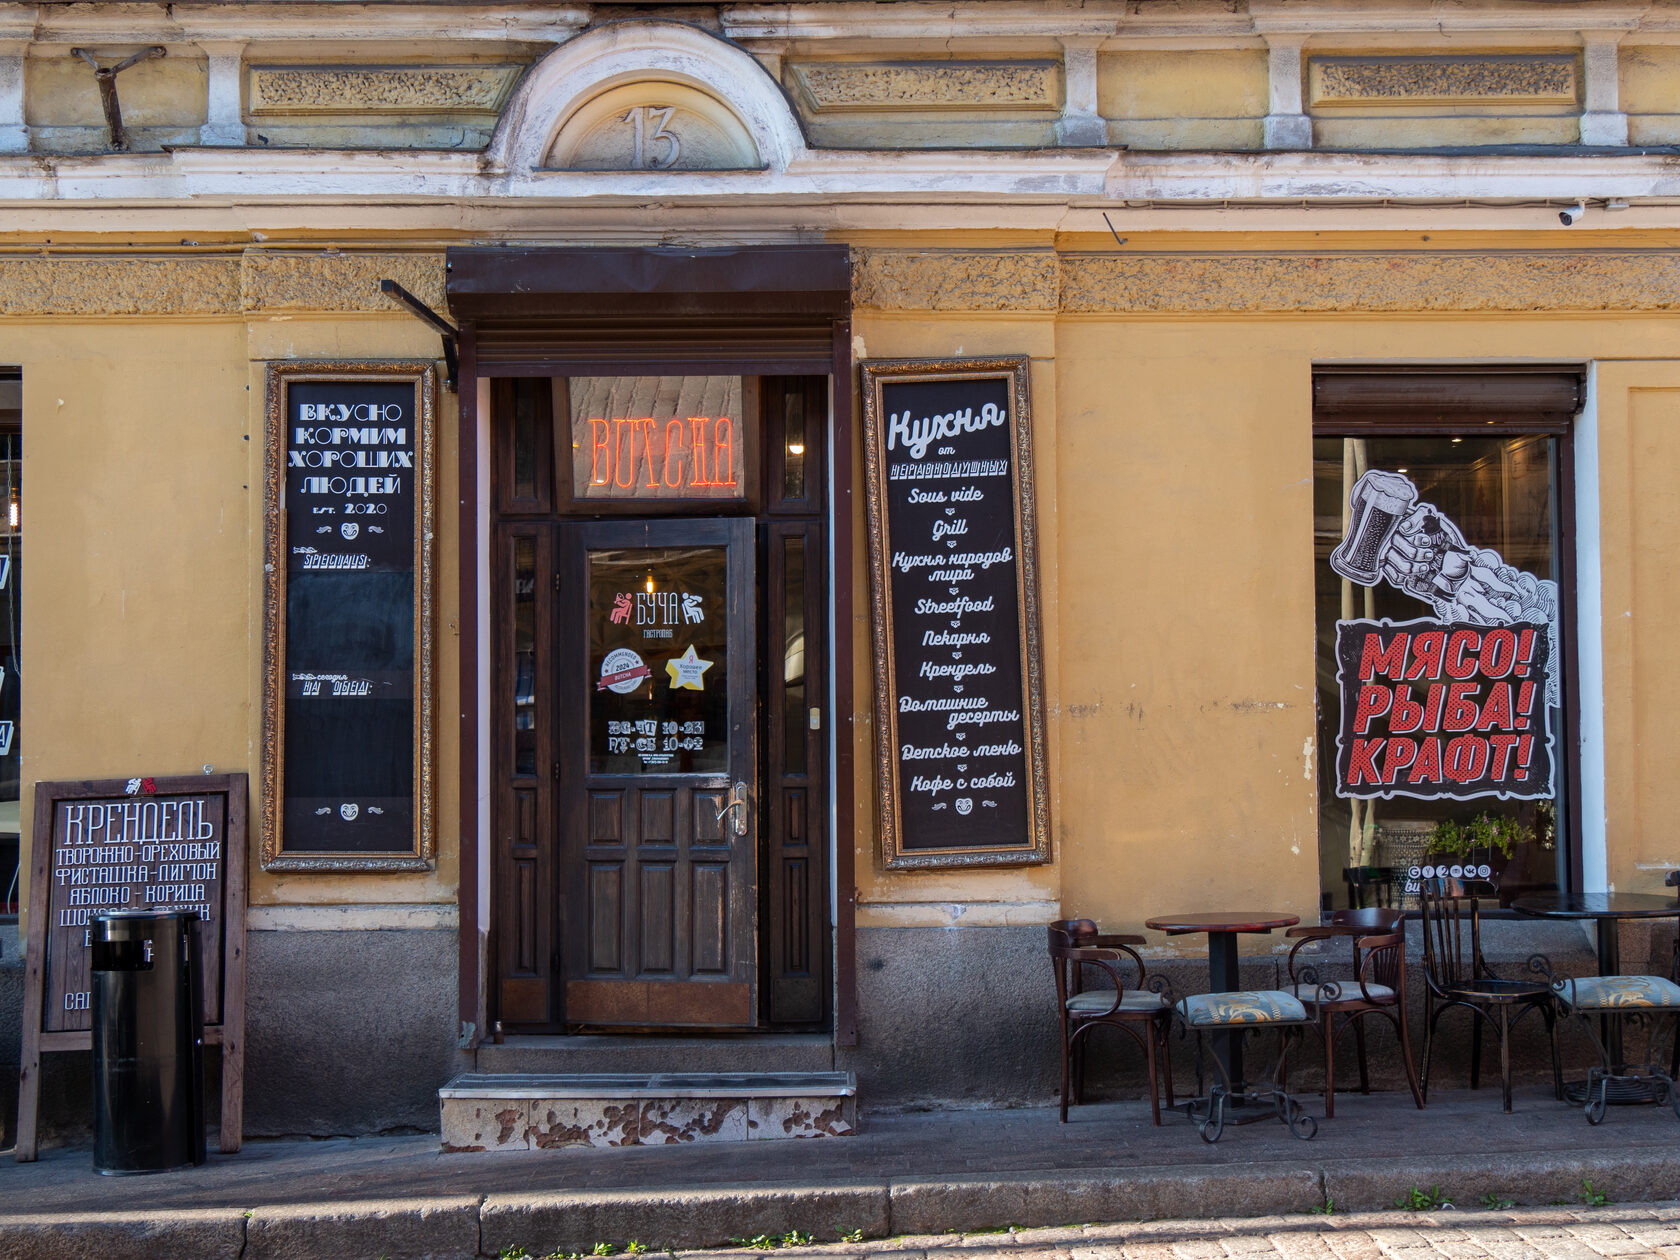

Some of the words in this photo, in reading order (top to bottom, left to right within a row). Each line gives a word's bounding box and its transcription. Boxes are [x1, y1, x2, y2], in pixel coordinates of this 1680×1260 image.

[624, 106, 680, 169] 13
[300, 404, 402, 421] ВКУСНО
[295, 427, 406, 445] КОРМИМ
[887, 402, 1006, 459] Кухня
[288, 450, 413, 468] ХОРОШИХ
[588, 417, 737, 488] BUTCHA
[938, 447, 955, 455] от
[890, 460, 1008, 480] НЕРАВНОДУШНЫХ
[300, 473, 400, 497] ЛЮДЕЙ
[907, 488, 948, 504] Sous
[950, 486, 984, 501] vide
[344, 503, 388, 515] 2020
[932, 518, 968, 541] Grill
[303, 554, 371, 569] SPECIALS:
[892, 551, 946, 573] Кухня
[947, 547, 1013, 569] народов
[928, 569, 975, 584] мира
[636, 592, 679, 625] БУЧА
[914, 596, 994, 619] Streetfood
[922, 630, 990, 648] Пекарня
[604, 651, 637, 667] RECOMMENDED
[1358, 629, 1537, 681] МЯСО!
[615, 662, 630, 672] 2024
[919, 661, 996, 681] Крендель
[302, 680, 321, 696] НА
[332, 680, 373, 696] ОБЕД:
[899, 695, 988, 713] Домашние
[1353, 681, 1537, 734] РЫБА!
[946, 709, 1019, 730] десерты
[901, 743, 970, 760] Детское
[973, 740, 1022, 757] меню
[1347, 734, 1535, 785] КРАФТ!
[910, 776, 953, 797] Кофе
[956, 779, 967, 790] с
[970, 772, 1016, 789] собой
[64, 800, 214, 845] КРЕНДЕЛЬ
[69, 886, 130, 906] ЯБЛОКО
[145, 884, 206, 903] КОРИЦА
